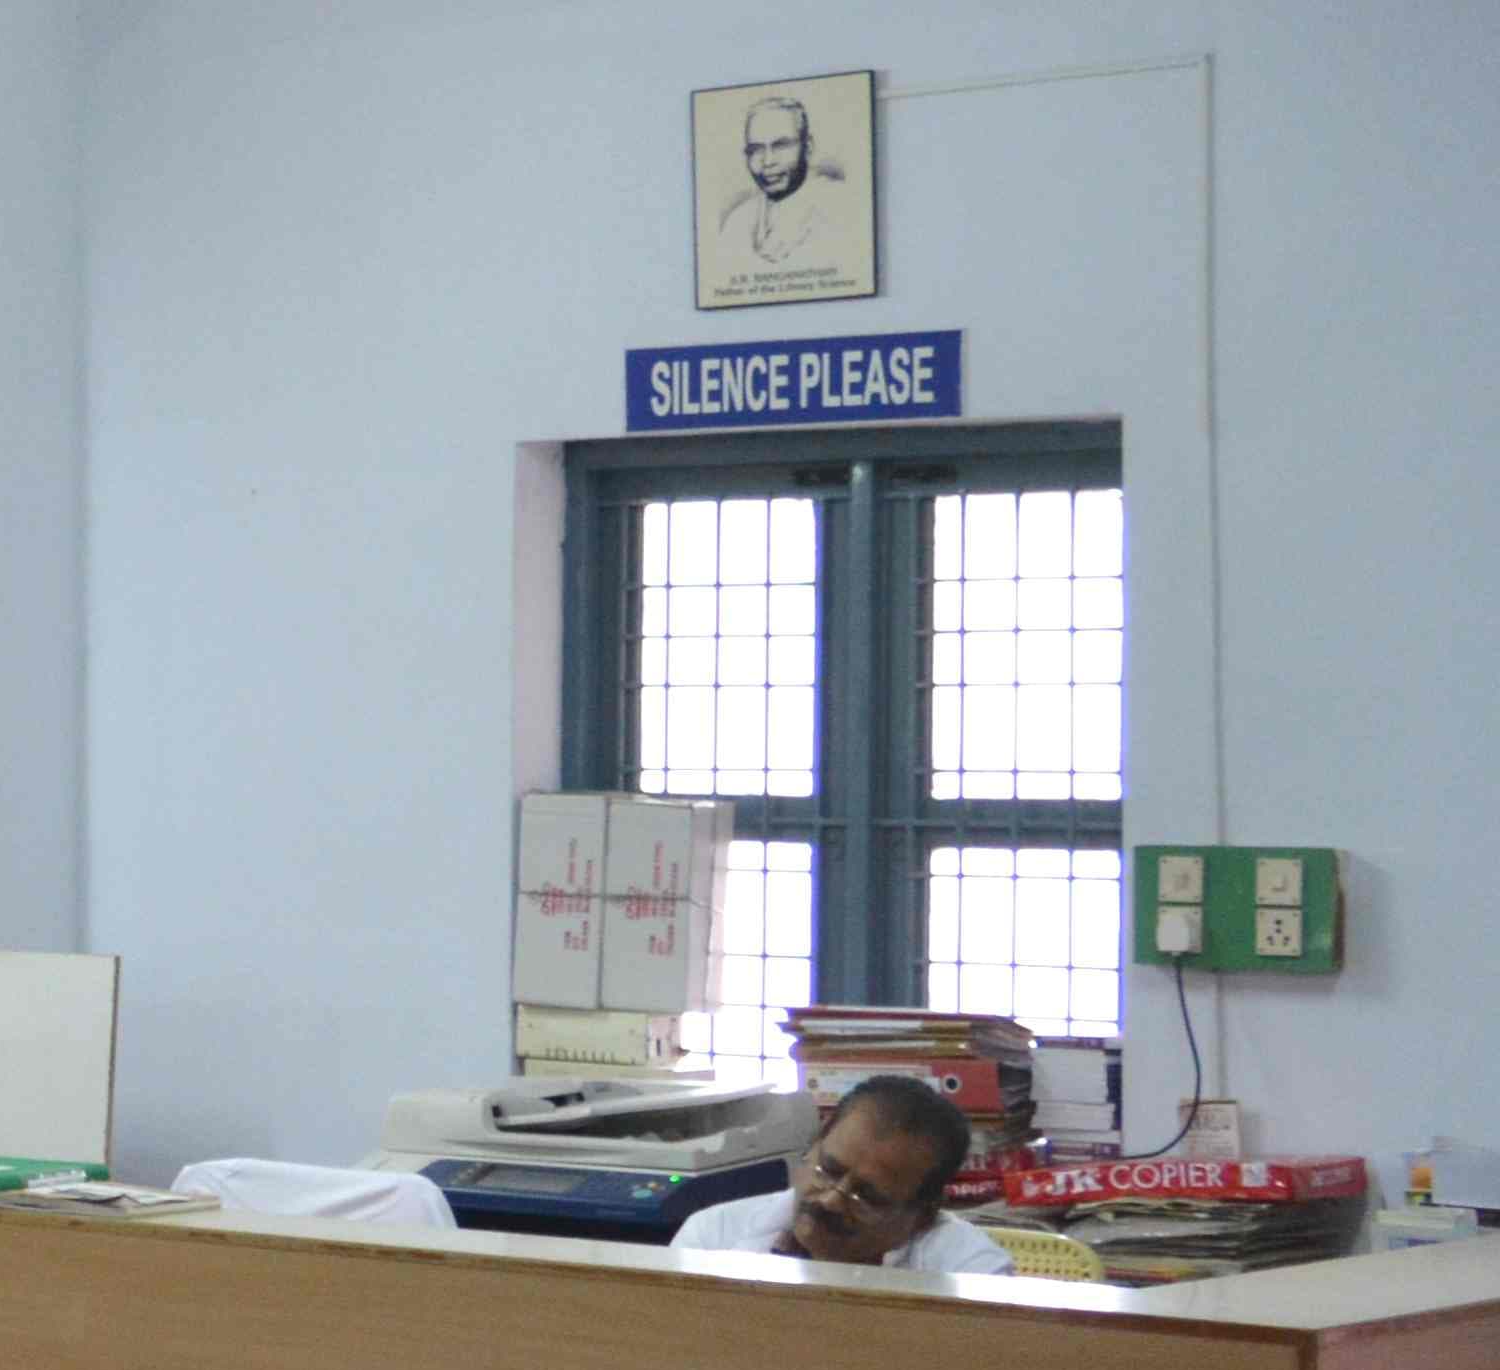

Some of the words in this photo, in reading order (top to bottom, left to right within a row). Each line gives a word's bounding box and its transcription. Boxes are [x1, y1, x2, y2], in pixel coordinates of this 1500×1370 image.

[650, 354, 791, 417] SILENCE
[800, 346, 935, 409] PLEASE
[1047, 1166, 1103, 1196] JK
[1108, 1162, 1223, 1189] COPIER
